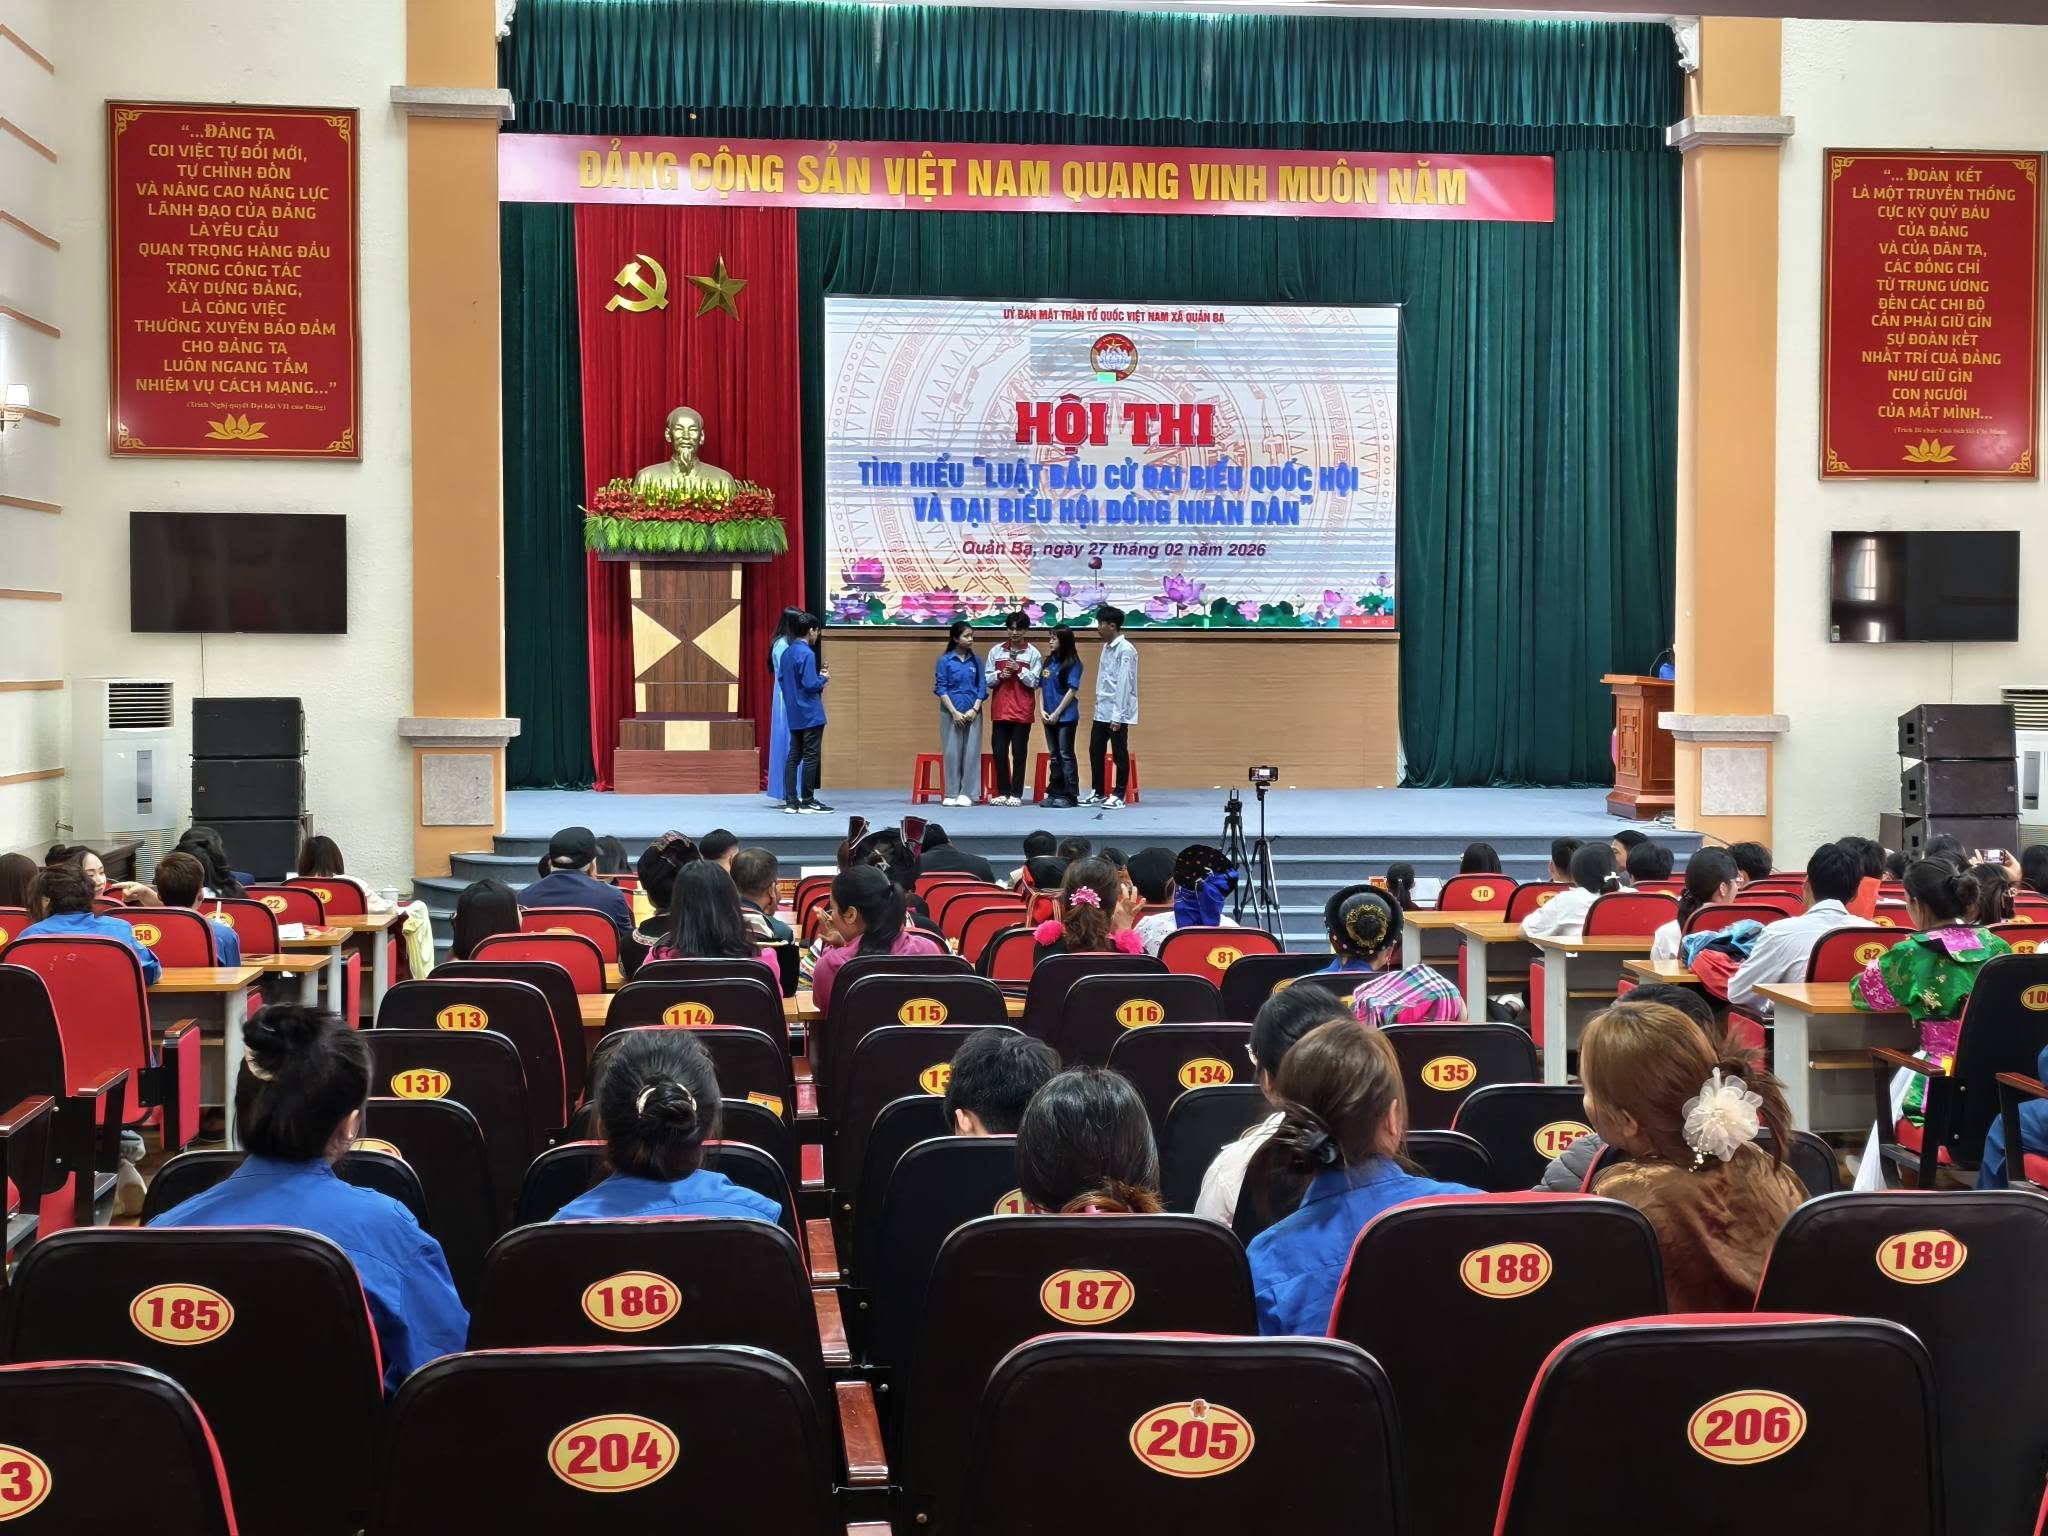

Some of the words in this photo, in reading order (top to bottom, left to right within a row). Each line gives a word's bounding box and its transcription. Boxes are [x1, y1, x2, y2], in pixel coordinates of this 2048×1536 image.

[256, 127, 275, 140] TA
[149, 144, 173, 156] COI
[179, 143, 214, 159] VIỆC
[218, 145, 238, 161] TỰ
[177, 163, 198, 178] TỰ
[579, 138, 678, 190] ĐẢNG
[690, 144, 783, 200] CỘNG
[798, 142, 871, 196] SẢN
[883, 150, 956, 203] VIỆT
[967, 159, 1050, 199] NAM
[1062, 161, 1179, 203] QUANG
[1190, 163, 1265, 201] VINH
[1279, 158, 1377, 204] MUÔN
[1388, 159, 1466, 206] NĂM
[1956, 166, 1982, 182] KẾT
[136, 181, 158, 195] VÀ
[163, 182, 208, 197] NÂNG
[214, 186, 244, 198] CAO
[250, 184, 294, 199] NĂNG
[300, 186, 329, 203] LỰC
[1874, 186, 1904, 201] MỘT
[1967, 185, 2015, 201] THỐNG
[198, 205, 231, 219] ĐẠO
[236, 201, 267, 218] CỦA
[272, 202, 316, 219] ĐẢNG
[1878, 205, 1903, 220] CỰC
[190, 221, 209, 236] LÀ
[213, 222, 242, 237] YÊU
[1898, 221, 1925, 237] CỦA
[1929, 222, 1968, 237] ĐẢNG
[139, 243, 183, 257] QUAN
[188, 244, 243, 259] TRỌNG
[1902, 240, 1929, 255] CỦA
[166, 263, 219, 276] TRONG
[225, 262, 267, 277] CÔNG
[167, 279, 199, 294] XÂY
[204, 280, 247, 297] DỰNG
[1898, 280, 1946, 292] TRUNG
[1950, 279, 1989, 292] ƯƠNG
[252, 300, 286, 317] VIỆC
[1127, 310, 1145, 323] VIỆT
[1148, 312, 1168, 321] NAM
[135, 317, 200, 333] THƯỜNG
[206, 319, 259, 334] XUYÊN
[300, 319, 336, 335] ĐẢM
[182, 341, 213, 352] CHO
[218, 337, 263, 353] ĐẢNG
[269, 342, 287, 353] TA
[1887, 332, 1905, 347] SỰ
[1888, 369, 1918, 381] NHƯ
[136, 377, 188, 394] NHIỆM
[193, 380, 214, 395] VỤ
[220, 377, 261, 393] CÁCH
[1893, 388, 1920, 400] CON
[1878, 402, 1905, 417] CỦA
[1015, 393, 1109, 455] HỘI
[1124, 403, 1215, 447] THI
[858, 456, 903, 486] TÌM
[910, 453, 964, 488] HIỂU
[1050, 456, 1097, 489] BẦU
[1104, 457, 1138, 489] CỬ
[1143, 465, 1183, 495] ĐẠI
[1190, 455, 1243, 491] BIỂU
[1250, 458, 1313, 493] QUỐC
[1319, 461, 1359, 497] HỘI
[913, 492, 945, 522] VÀ
[951, 497, 991, 528] ĐẠI
[999, 489, 1051, 523] BIỂU
[1060, 494, 1099, 529] HỘI
[1178, 495, 1244, 525] NHÂN
[963, 540, 1005, 555] Quản
[1043, 542, 1083, 557] ngày
[1088, 542, 1111, 555] 27
[1113, 543, 1158, 558] tháng
[1165, 543, 1183, 556] 02
[1188, 543, 1222, 556] năm
[1228, 543, 1266, 557] 2026
[1478, 890, 1488, 898] 10
[266, 900, 280, 908] 22
[134, 930, 152, 941] 58
[1218, 952, 1234, 964] 81
[1864, 948, 1880, 960] 82
[2027, 990, 2048, 1004] 10
[445, 1012, 481, 1028] 113
[671, 1010, 708, 1025] 114
[906, 1006, 941, 1021] 115
[1124, 1006, 1158, 1022] 116
[929, 1070, 953, 1088] 13
[1186, 1066, 1226, 1084] 134
[1430, 1064, 1469, 1082] 135
[403, 1074, 441, 1094] 131
[1892, 1240, 1955, 1270] 189
[1475, 1254, 1541, 1284] 188
[597, 1284, 668, 1317] 186
[1055, 1280, 1123, 1310] 187
[148, 1297, 220, 1331] 185
[1703, 1406, 1790, 1447] 206
[1146, 1418, 1239, 1460] 205
[567, 1431, 662, 1475] 204
